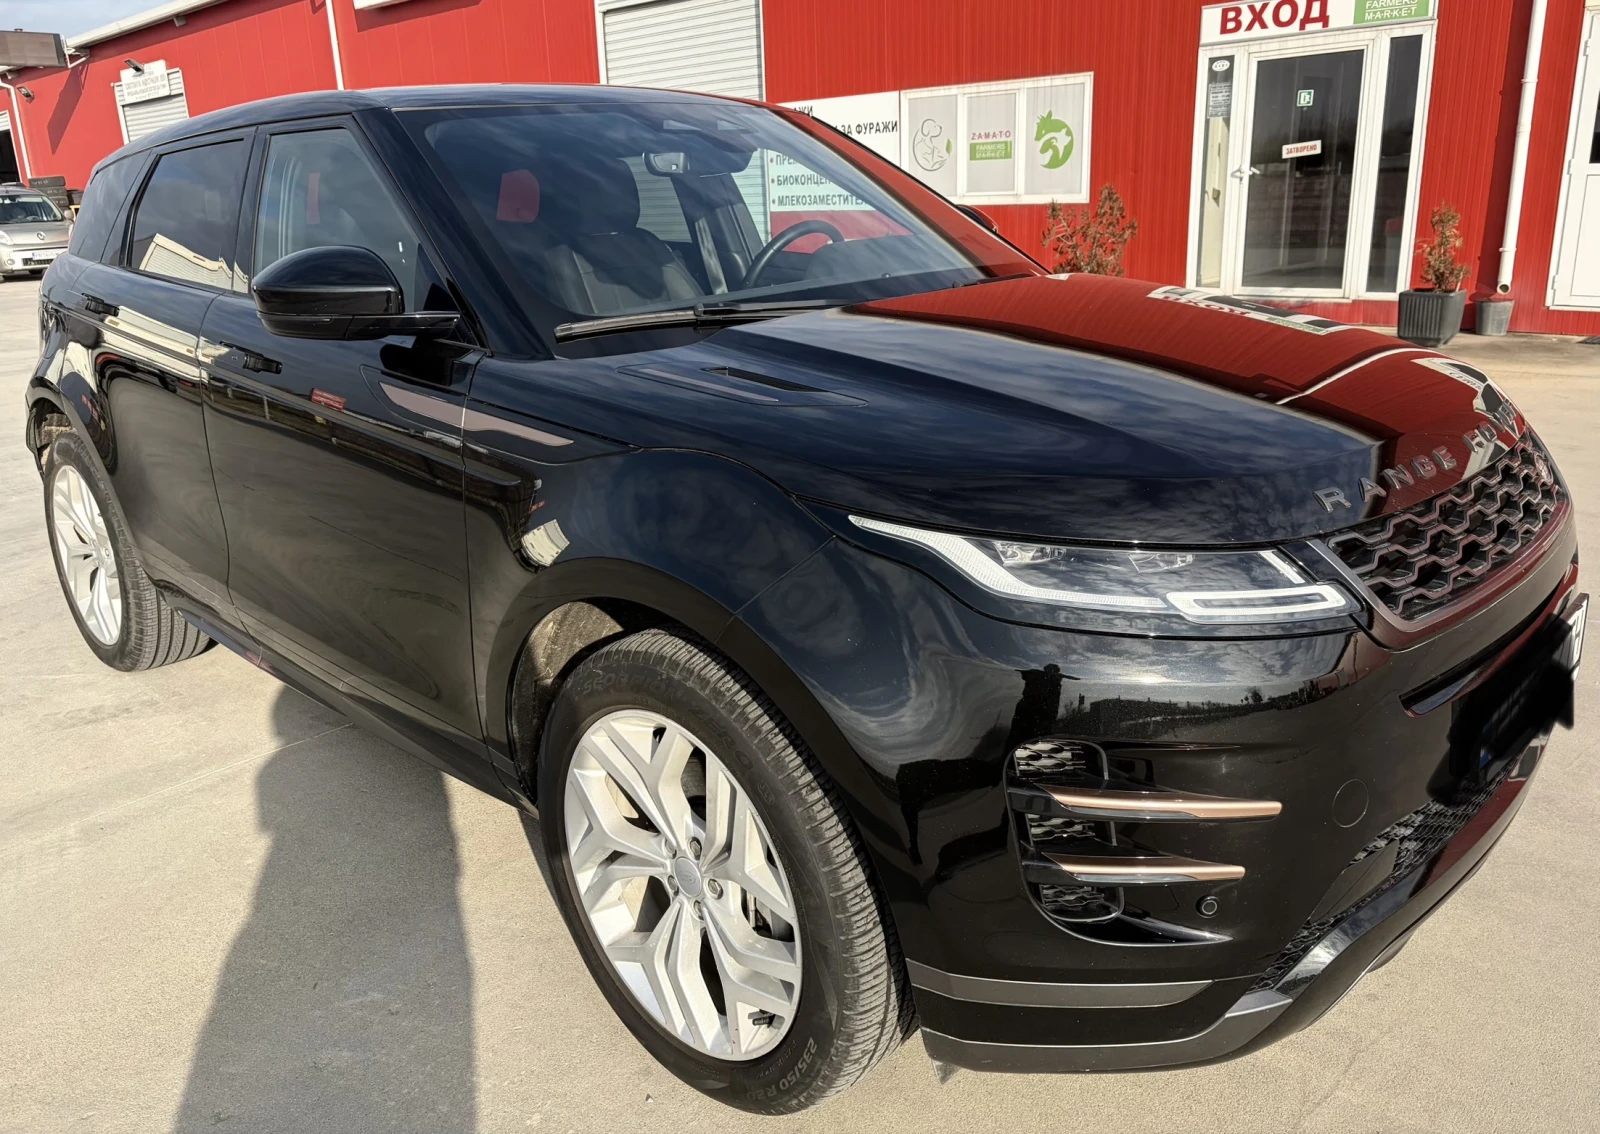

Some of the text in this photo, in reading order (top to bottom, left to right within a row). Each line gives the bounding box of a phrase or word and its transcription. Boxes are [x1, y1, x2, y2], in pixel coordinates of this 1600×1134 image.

[1219, 0, 1330, 35] ВХОД
[841, 120, 898, 135] ЗА ФУРАЖИ
[976, 143, 1006, 151] FARMERS
[1286, 144, 1317, 155] ЗАТВОРЕНО
[1312, 446, 1457, 513] RANGE
[780, 1036, 818, 1090] 235/50
